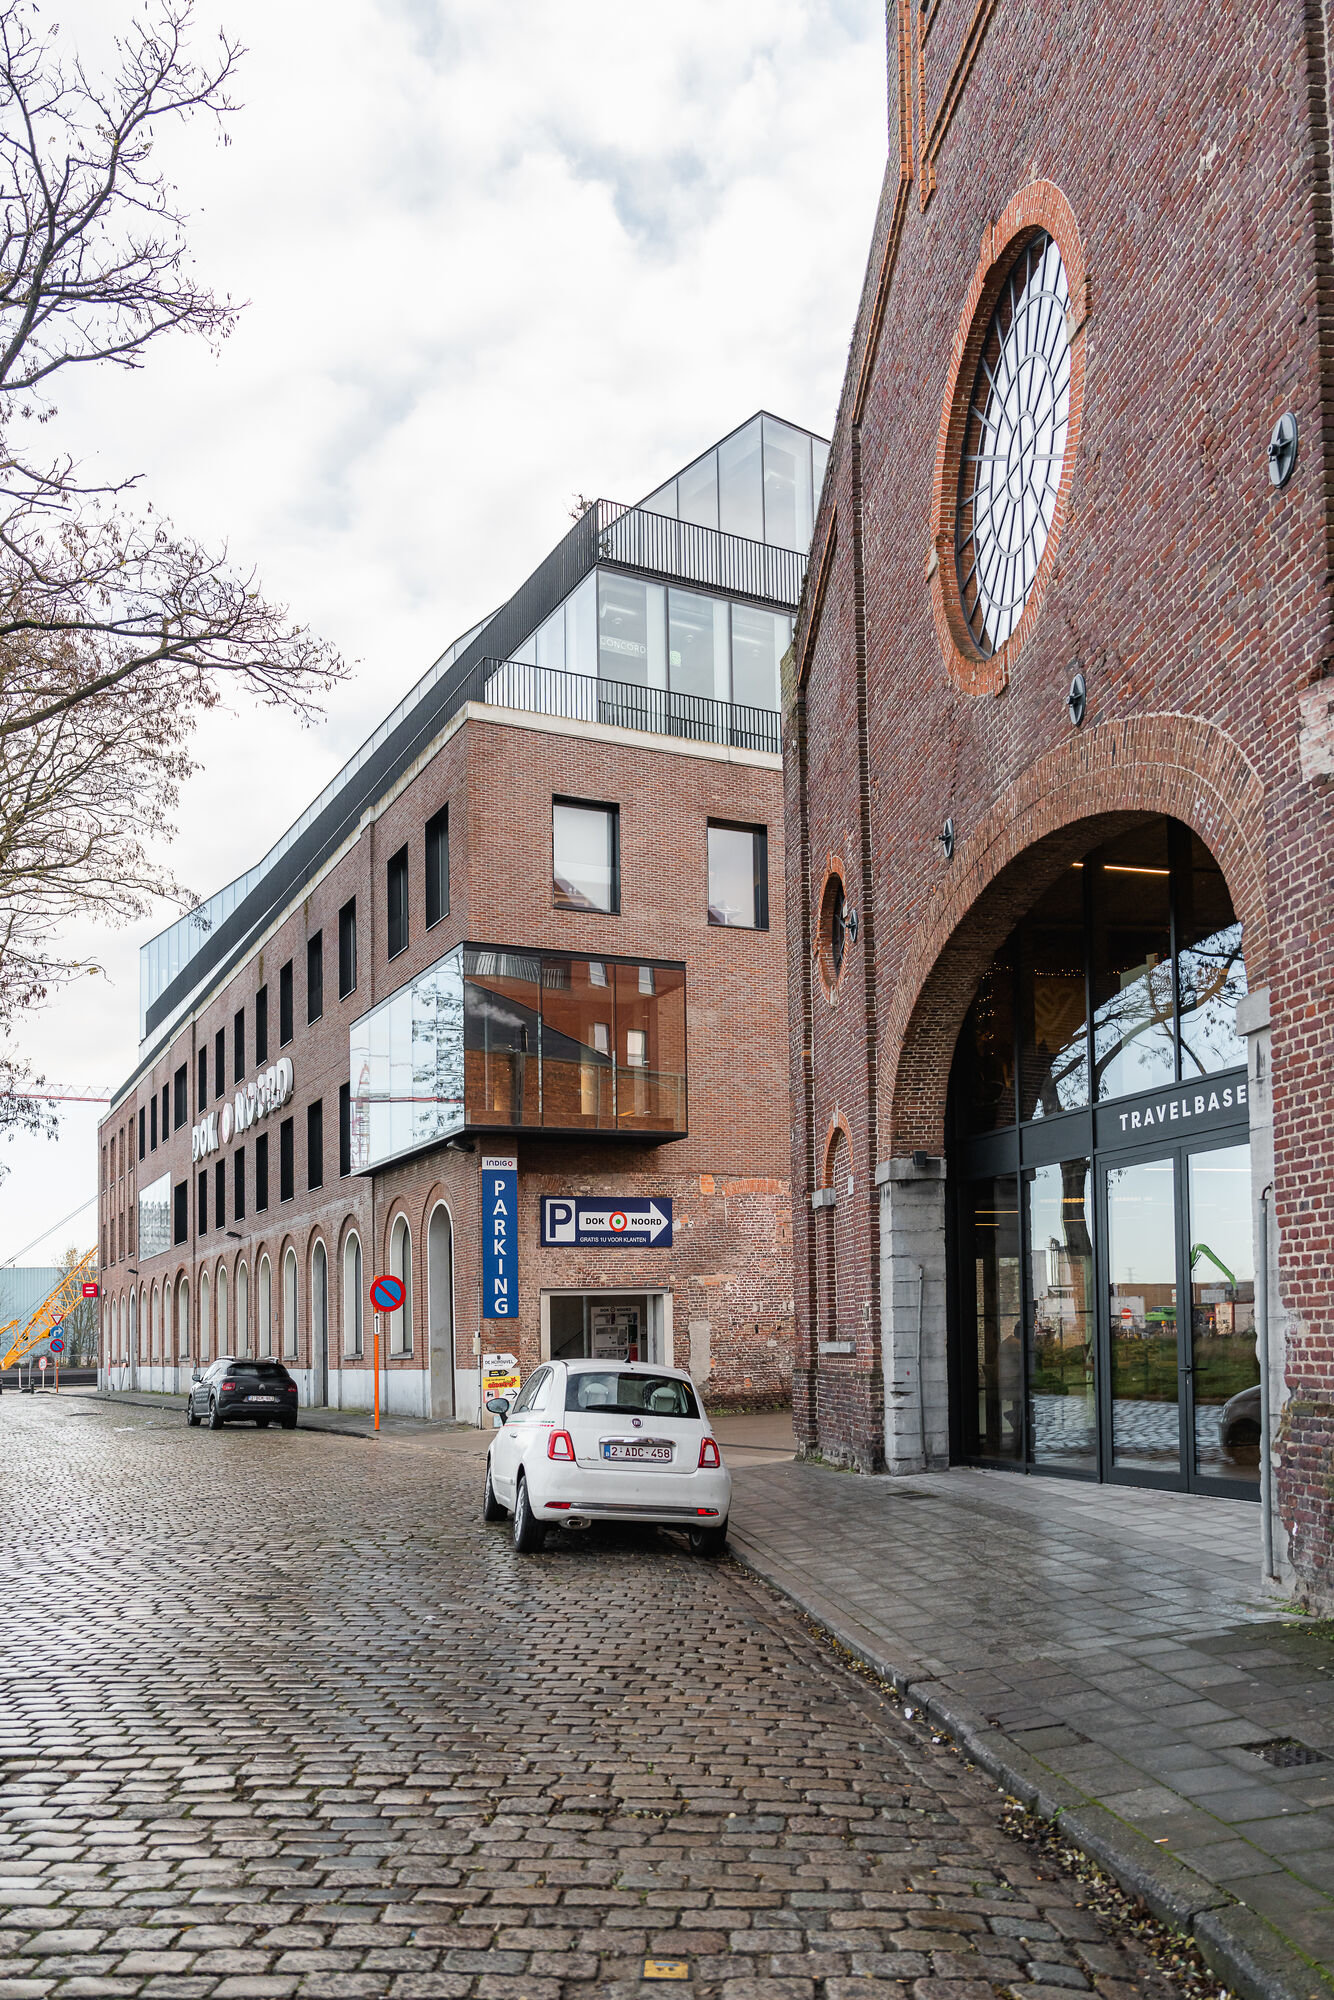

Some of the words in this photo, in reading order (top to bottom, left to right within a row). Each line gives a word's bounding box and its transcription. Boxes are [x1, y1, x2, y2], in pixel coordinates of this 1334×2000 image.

[192, 1111, 219, 1163] DOK
[234, 1057, 294, 1134] NOORD
[1119, 1084, 1247, 1131] TRAVELBASE
[549, 1203, 572, 1238] P
[585, 1217, 605, 1225] DOK
[631, 1218, 662, 1226] NOORD
[492, 1180, 509, 1314] PARKING
